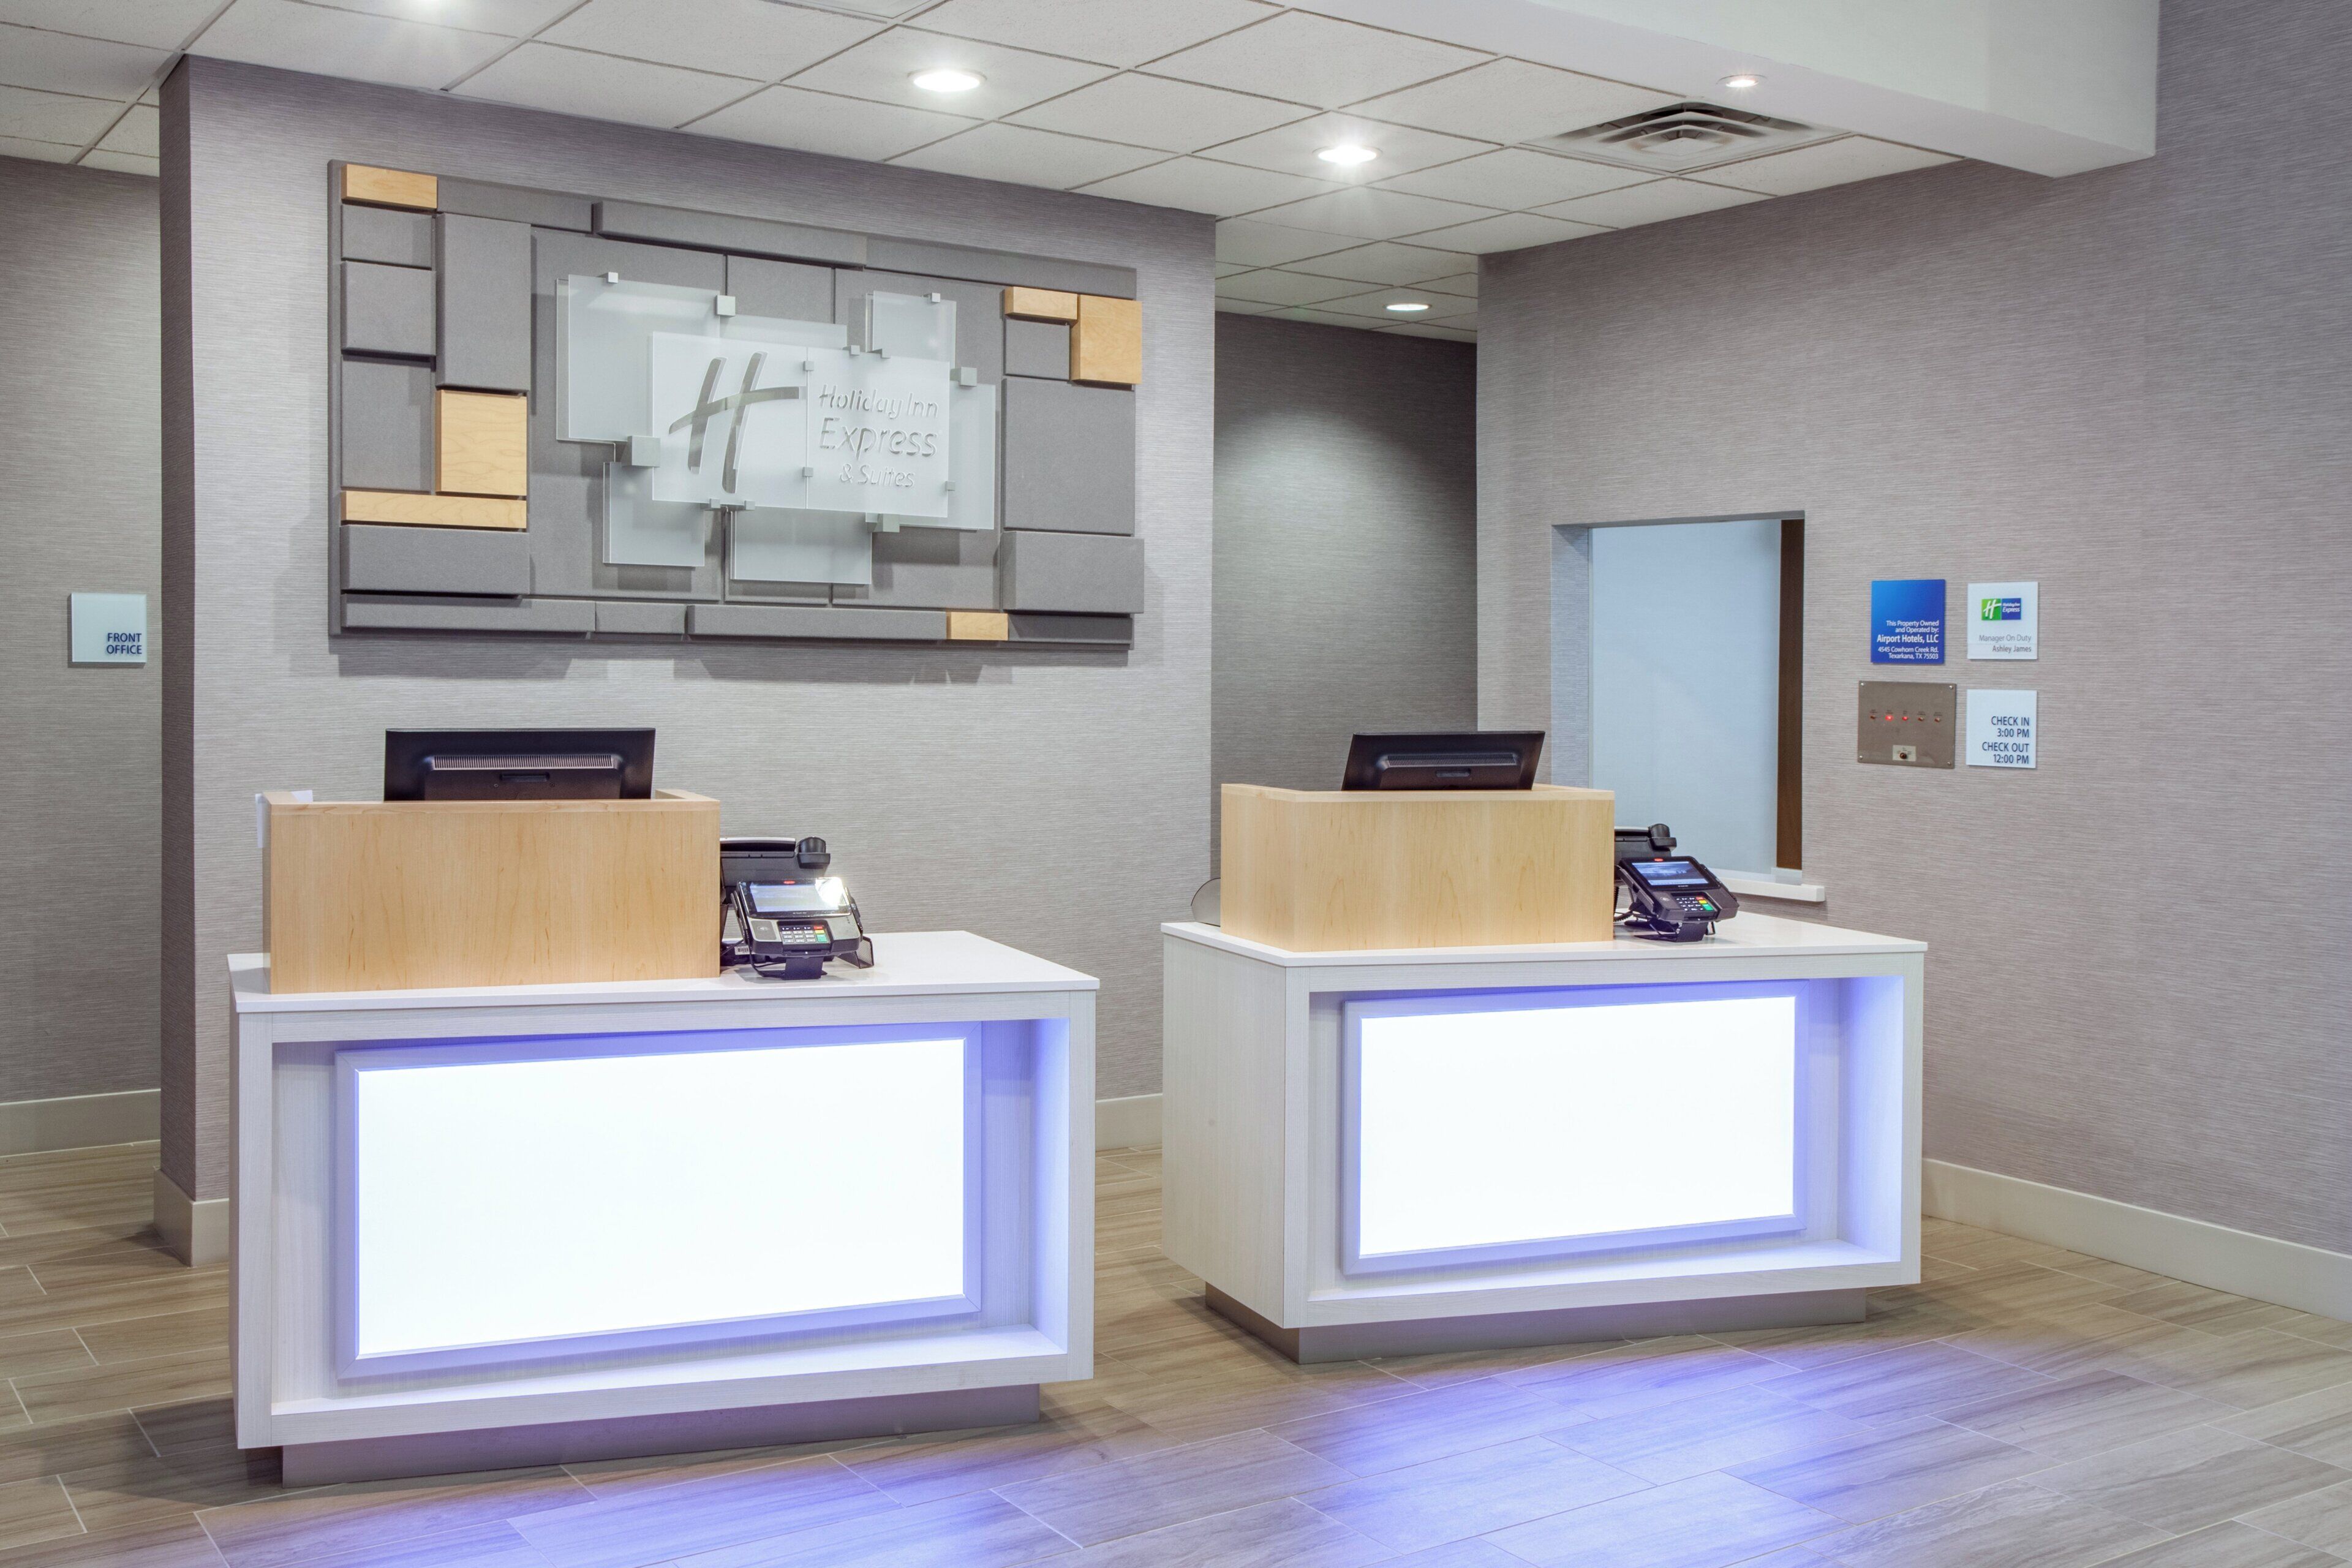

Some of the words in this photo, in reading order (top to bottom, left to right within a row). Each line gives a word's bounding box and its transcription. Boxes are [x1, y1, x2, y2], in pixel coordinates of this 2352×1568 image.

[819, 385, 903, 420] Holiday
[907, 393, 938, 418] Inn
[820, 417, 937, 460] Express
[840, 463, 853, 483] &
[858, 464, 915, 488] Suites
[107, 633, 142, 642] FRONT
[1877, 634, 1901, 644] Airport
[1902, 634, 1924, 643] Hotels,
[1979, 635, 2004, 643] Manager
[107, 645, 142, 654] OFFICE
[1992, 645, 2011, 654] Ashley
[1991, 716, 2018, 726] CHECK
[2021, 717, 2029, 726] IN
[1997, 728, 2014, 737] 3:00
[2017, 728, 2029, 737] PM
[1982, 742, 2009, 752] CHECK
[2011, 743, 2029, 752] OUT
[1994, 754, 2014, 763] 12:00
[2016, 755, 2029, 764] PM
